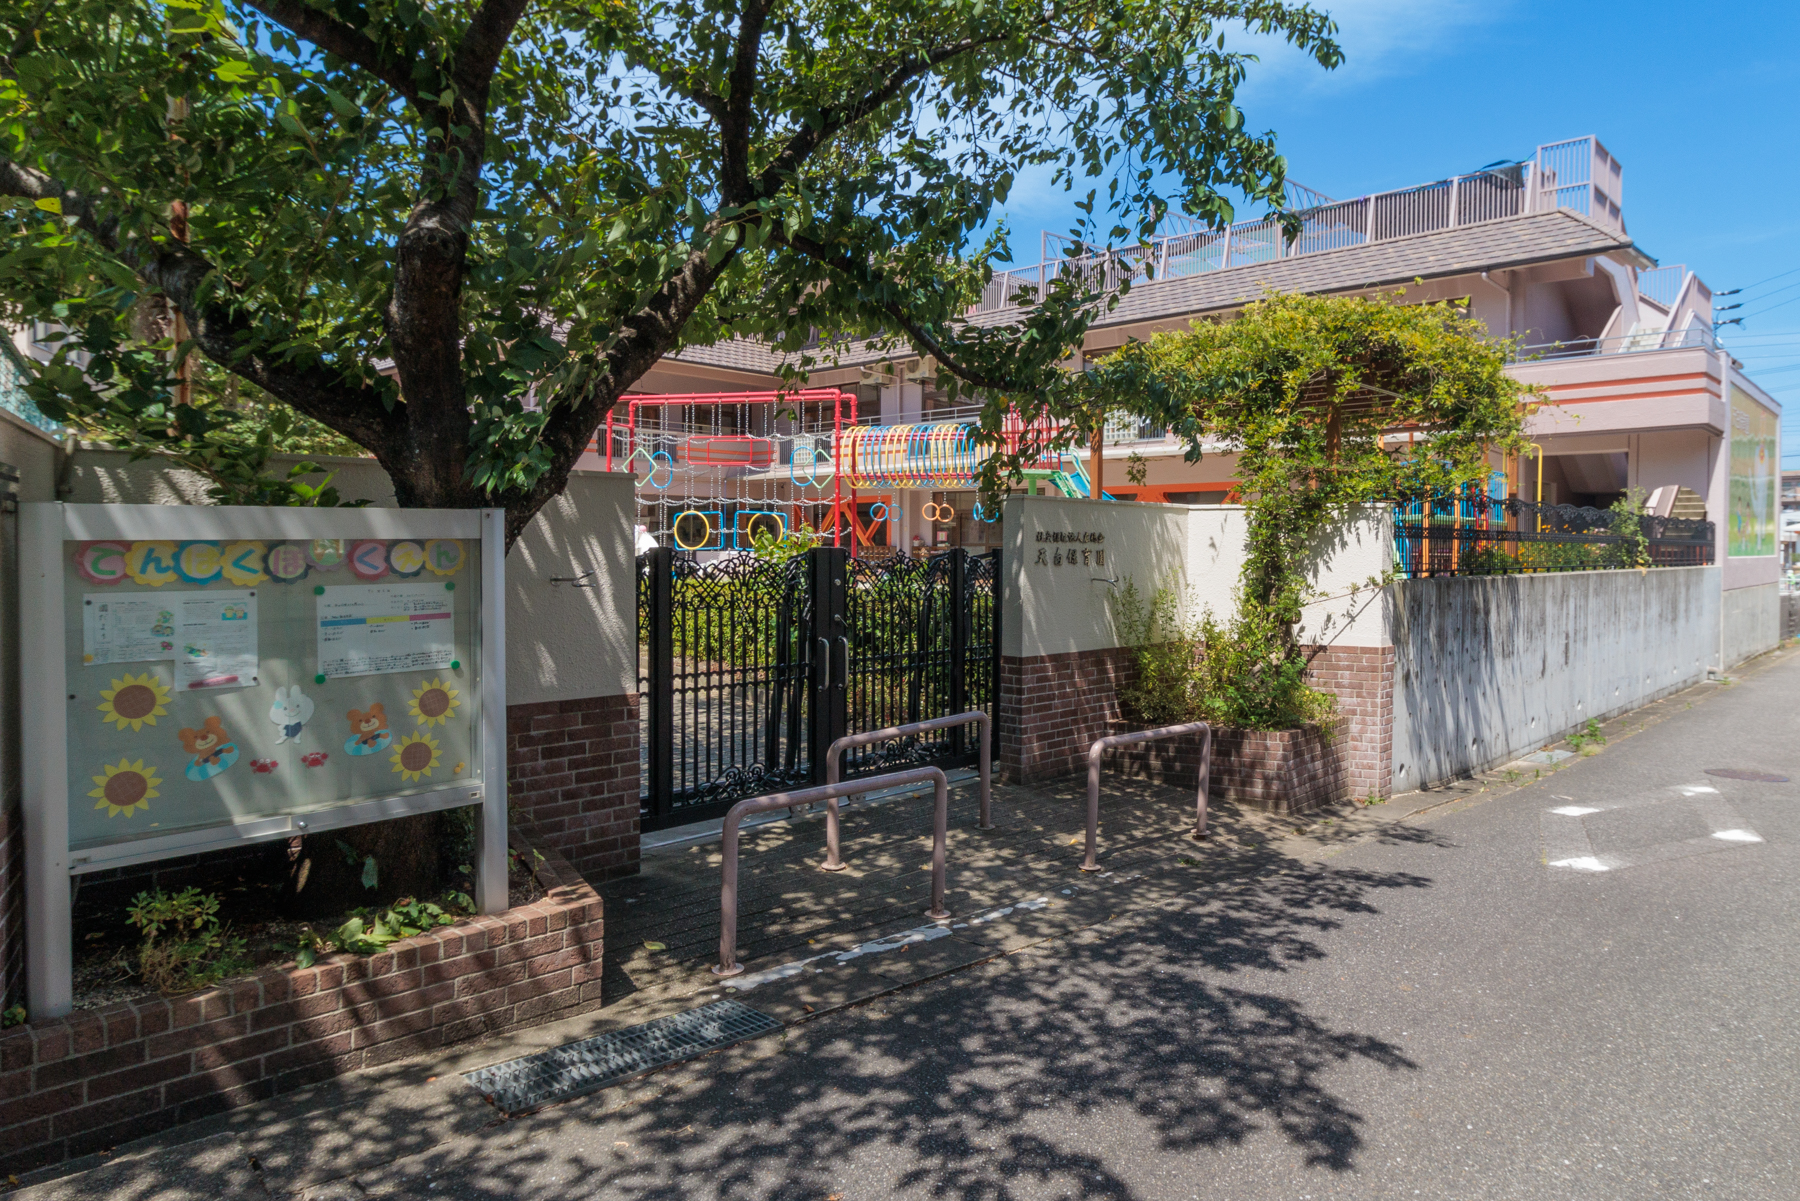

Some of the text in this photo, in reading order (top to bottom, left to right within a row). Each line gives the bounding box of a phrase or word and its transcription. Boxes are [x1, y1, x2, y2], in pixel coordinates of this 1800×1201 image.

[1035, 547, 1104, 567] 天白保育園
